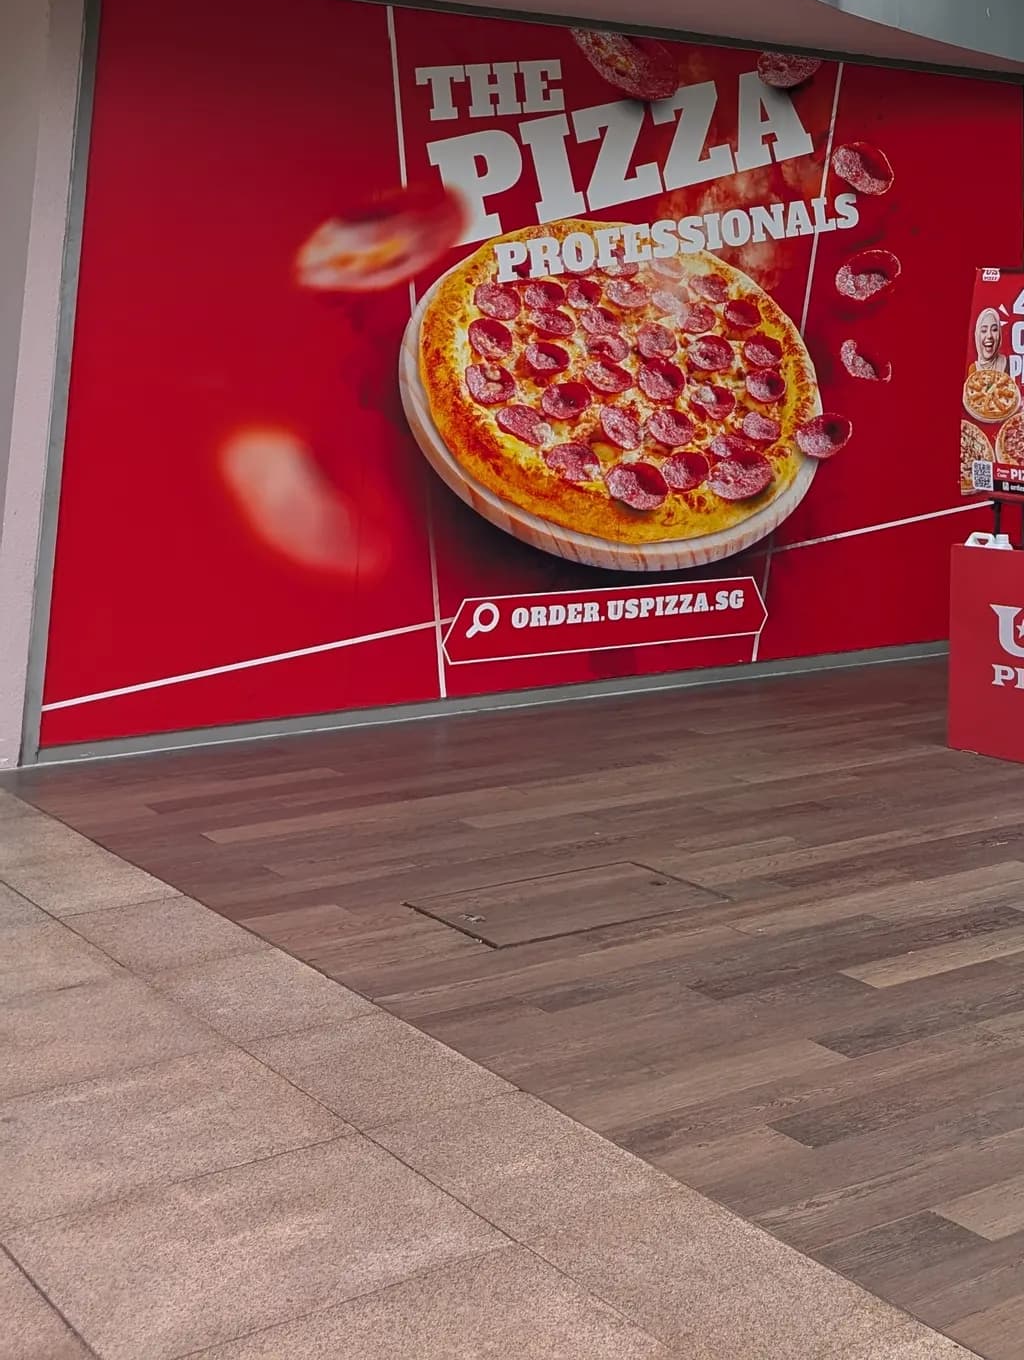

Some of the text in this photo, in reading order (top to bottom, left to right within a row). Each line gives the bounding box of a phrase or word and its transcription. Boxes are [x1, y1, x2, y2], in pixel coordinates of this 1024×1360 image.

[415, 59, 565, 121] THE
[427, 71, 815, 247] PIZZA
[494, 193, 860, 284] PROFESSIONALS
[511, 590, 745, 629] ORDER.USPIZZA.SG
